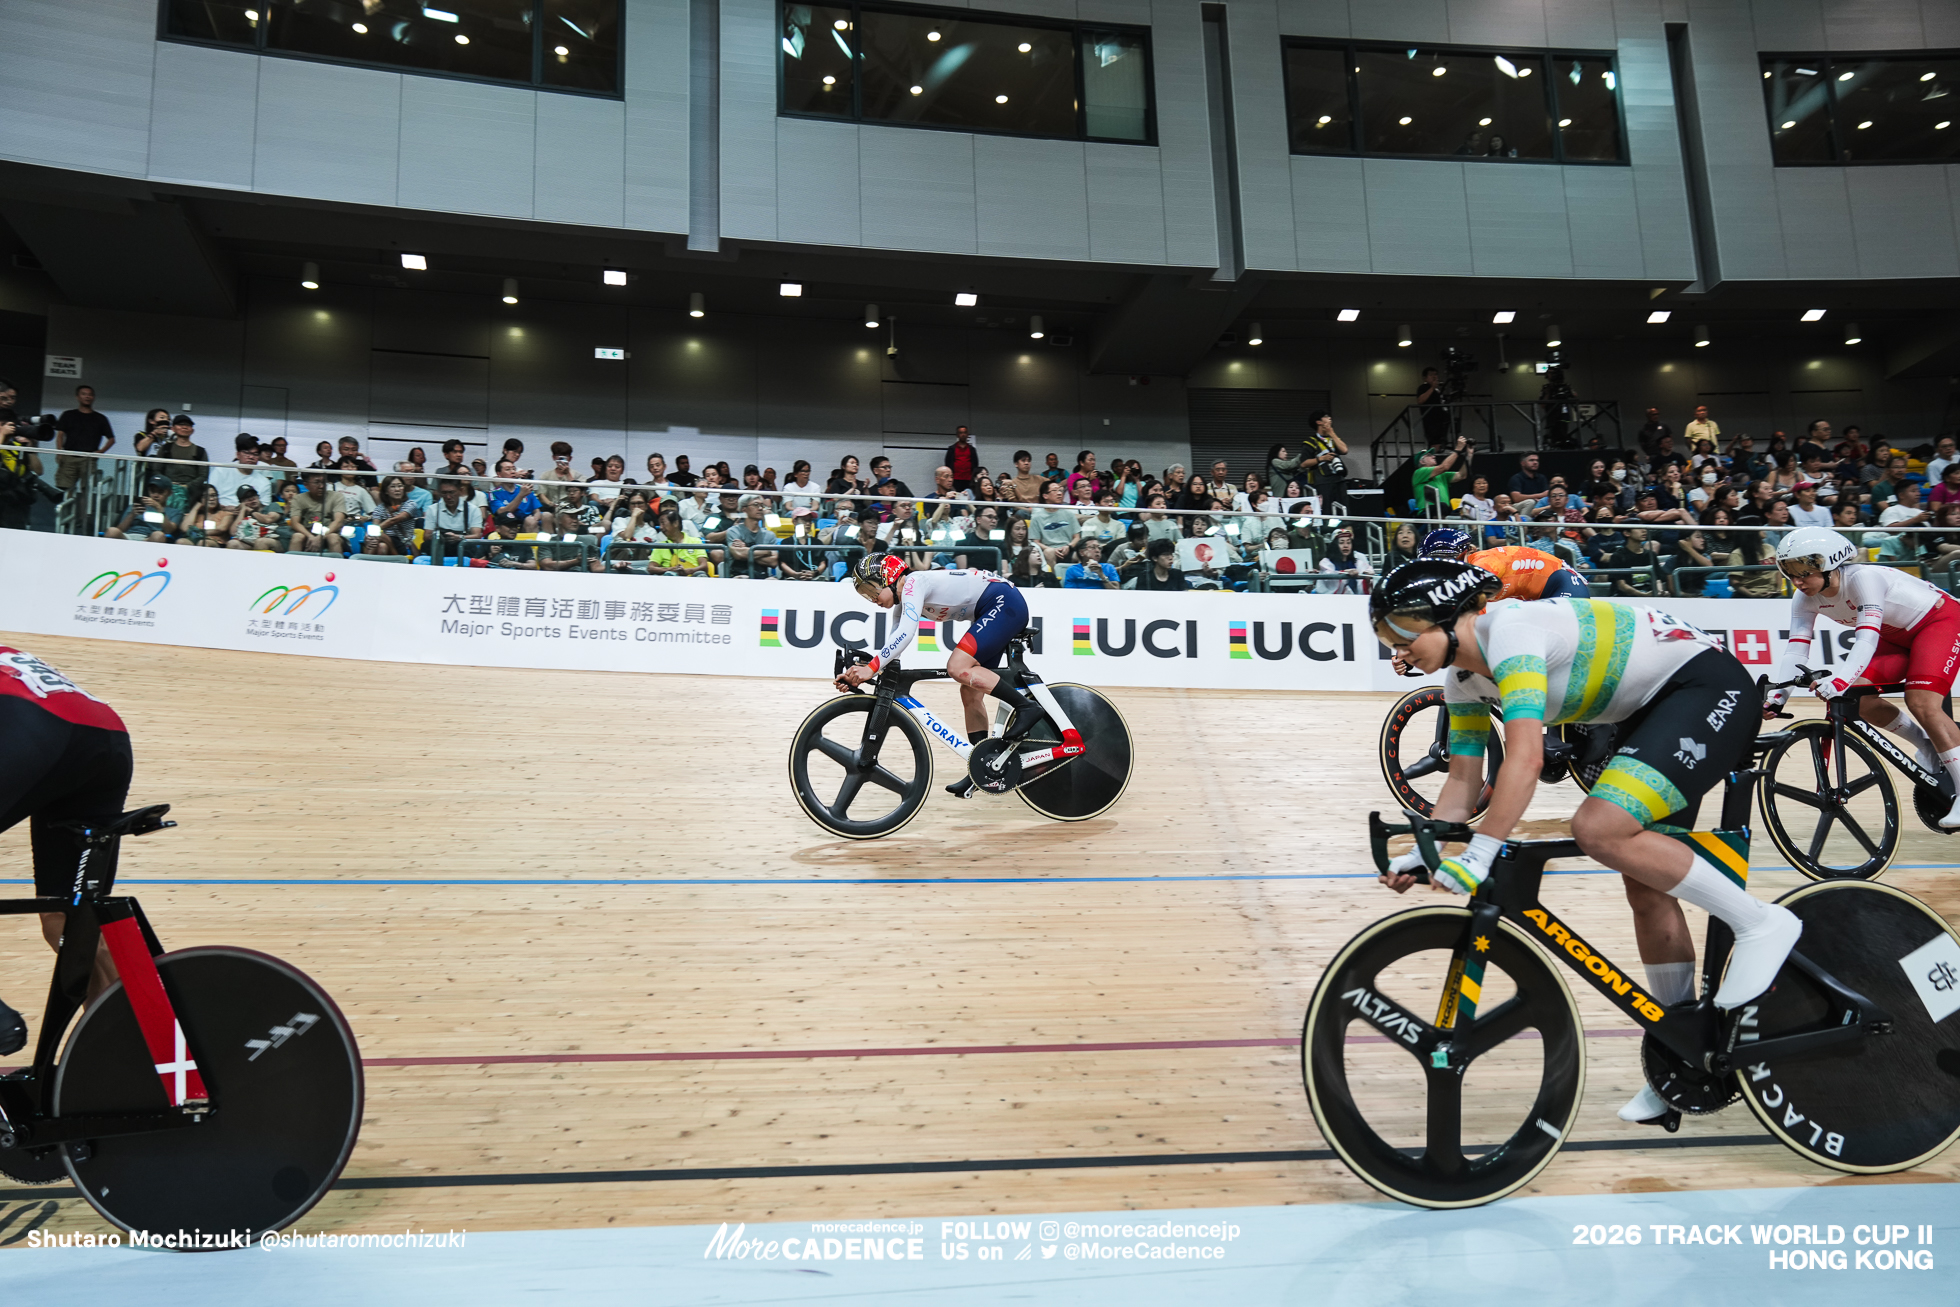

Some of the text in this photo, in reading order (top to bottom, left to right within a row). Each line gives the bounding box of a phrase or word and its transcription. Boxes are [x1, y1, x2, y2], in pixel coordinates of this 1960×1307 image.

[1427, 569, 1482, 606] KASK
[74, 614, 155, 627] Major Sports Events
[441, 593, 733, 625] 大型體育活動事務委員會
[976, 594, 1005, 633] JAPAN
[246, 628, 324, 641] Major Sports Events
[441, 619, 731, 645] Major Sports Events Committee
[785, 609, 887, 650] UCI
[889, 632, 907, 650] Cyclers
[1097, 618, 1198, 658] UCI
[1253, 621, 1355, 662] UCI
[1943, 633, 1960, 674] POLSK
[1025, 752, 1051, 763] JAPAN
[1673, 750, 1697, 770] AIS
[1853, 720, 1939, 787] ARGON 18
[1522, 908, 1665, 1022] ARGON 18
[1440, 988, 1458, 1029] RGON
[1740, 1005, 1845, 1157] BLACK IN
